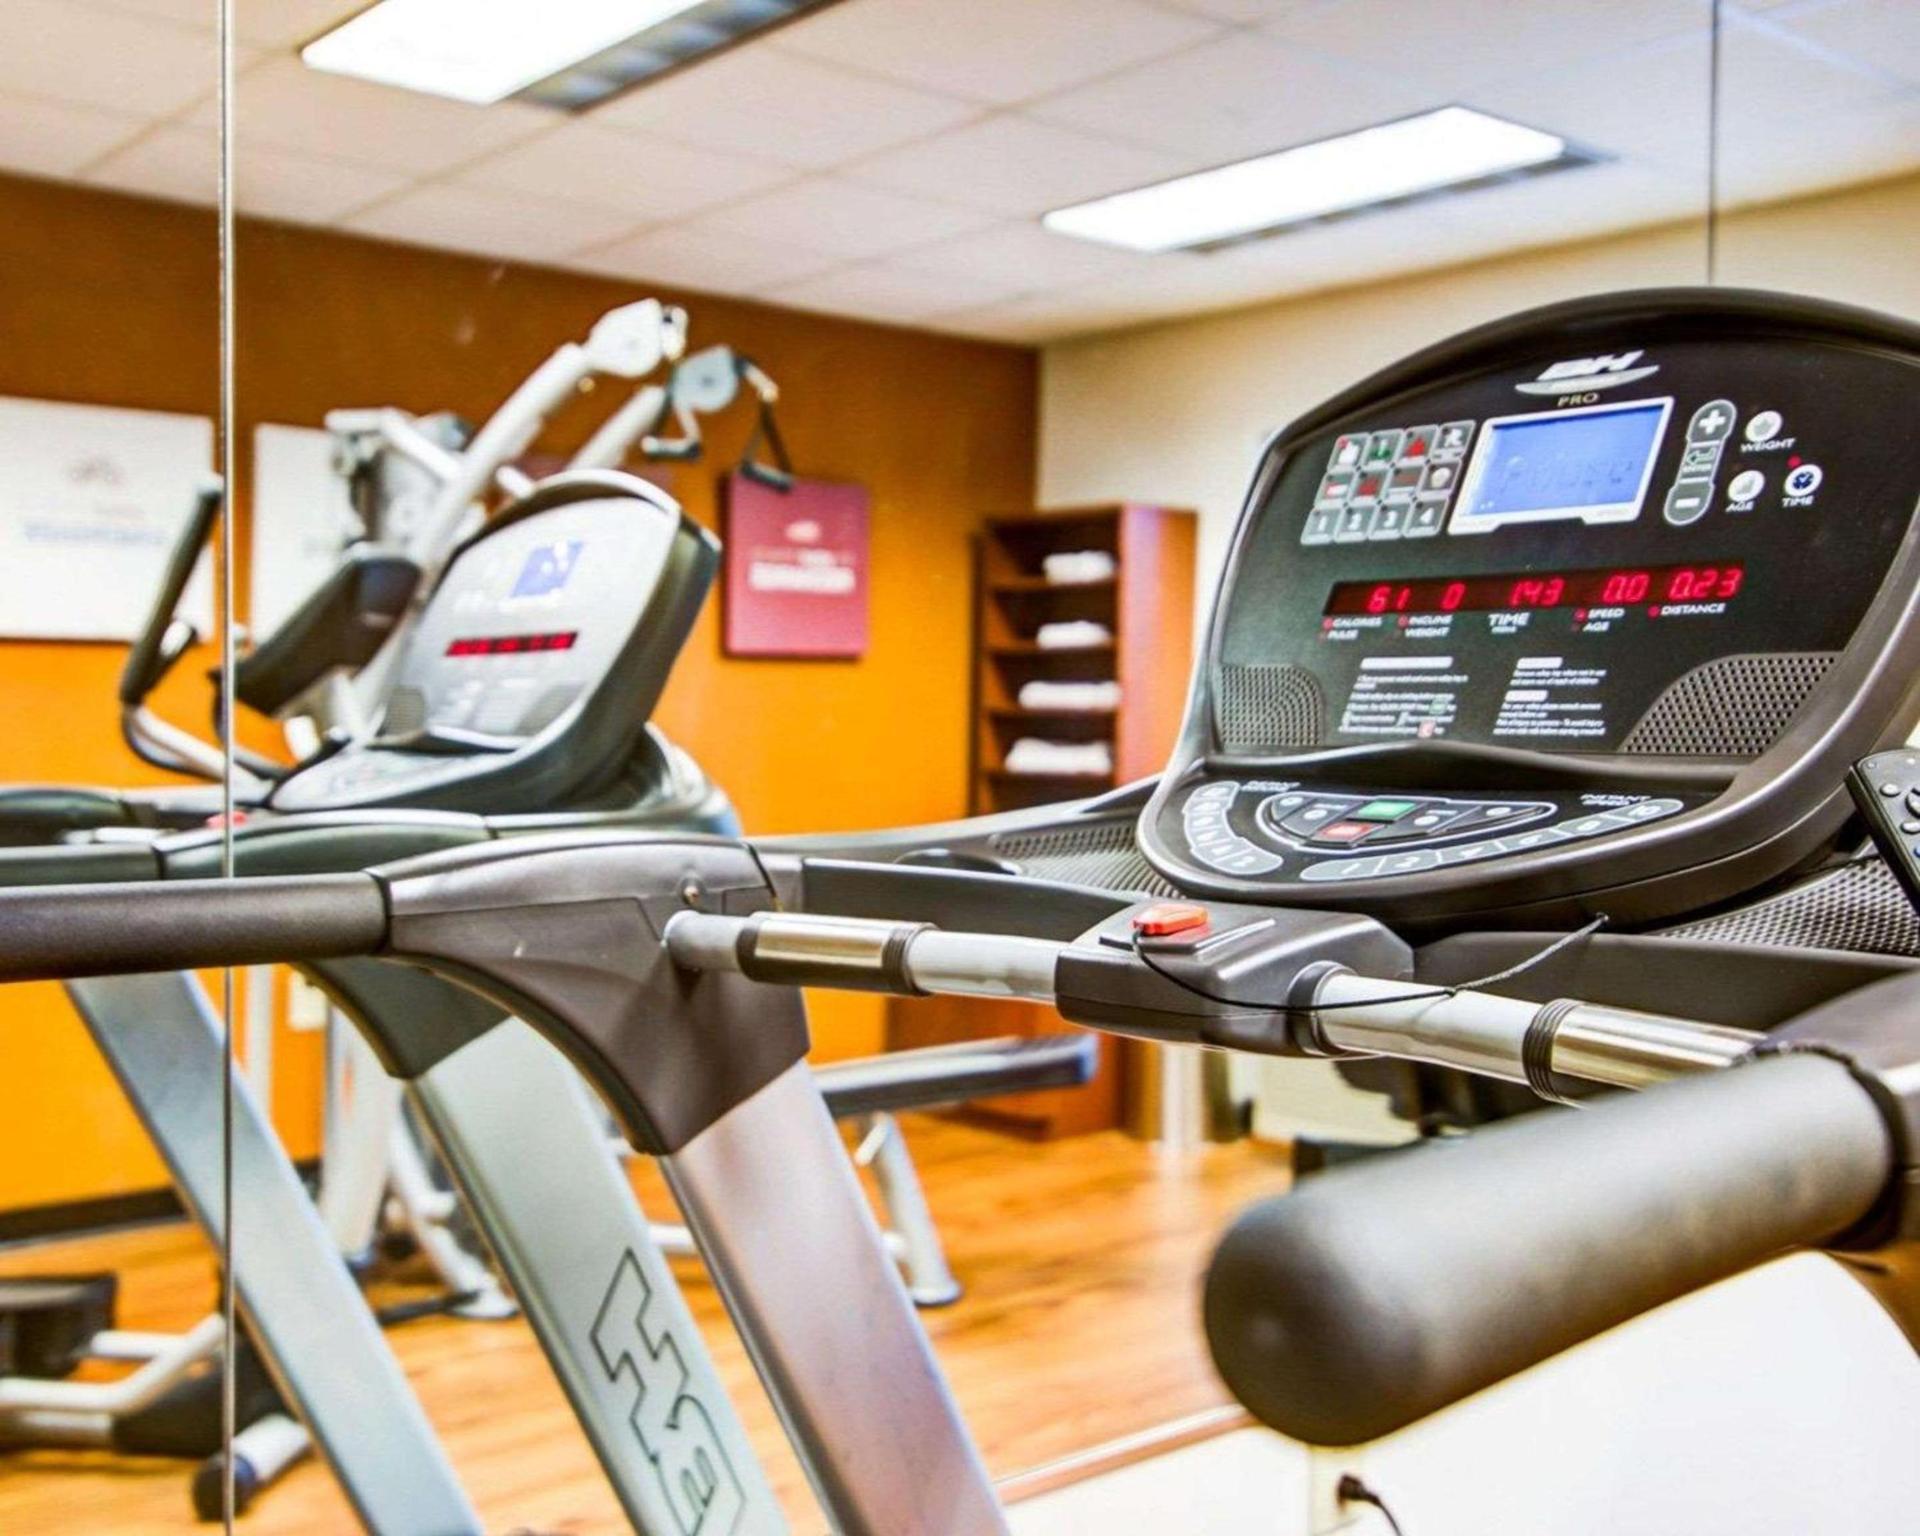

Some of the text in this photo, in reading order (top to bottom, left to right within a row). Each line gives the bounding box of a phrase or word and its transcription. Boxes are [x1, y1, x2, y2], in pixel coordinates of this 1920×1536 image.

[1557, 392, 1599, 407] PRO
[1741, 438, 1796, 452] WEIGHT
[1725, 501, 1754, 512] AGE
[1782, 496, 1815, 508] TIME
[1347, 513, 1363, 531] 2
[1383, 510, 1398, 528] 3
[1420, 507, 1435, 524] 4
[1317, 515, 1328, 532] 1
[1440, 581, 1466, 611] 0
[1587, 607, 1625, 619] SPEED
[1660, 603, 1726, 616] DISTANCE
[1488, 612, 1531, 627] TIME
[1582, 621, 1611, 632] AGE
